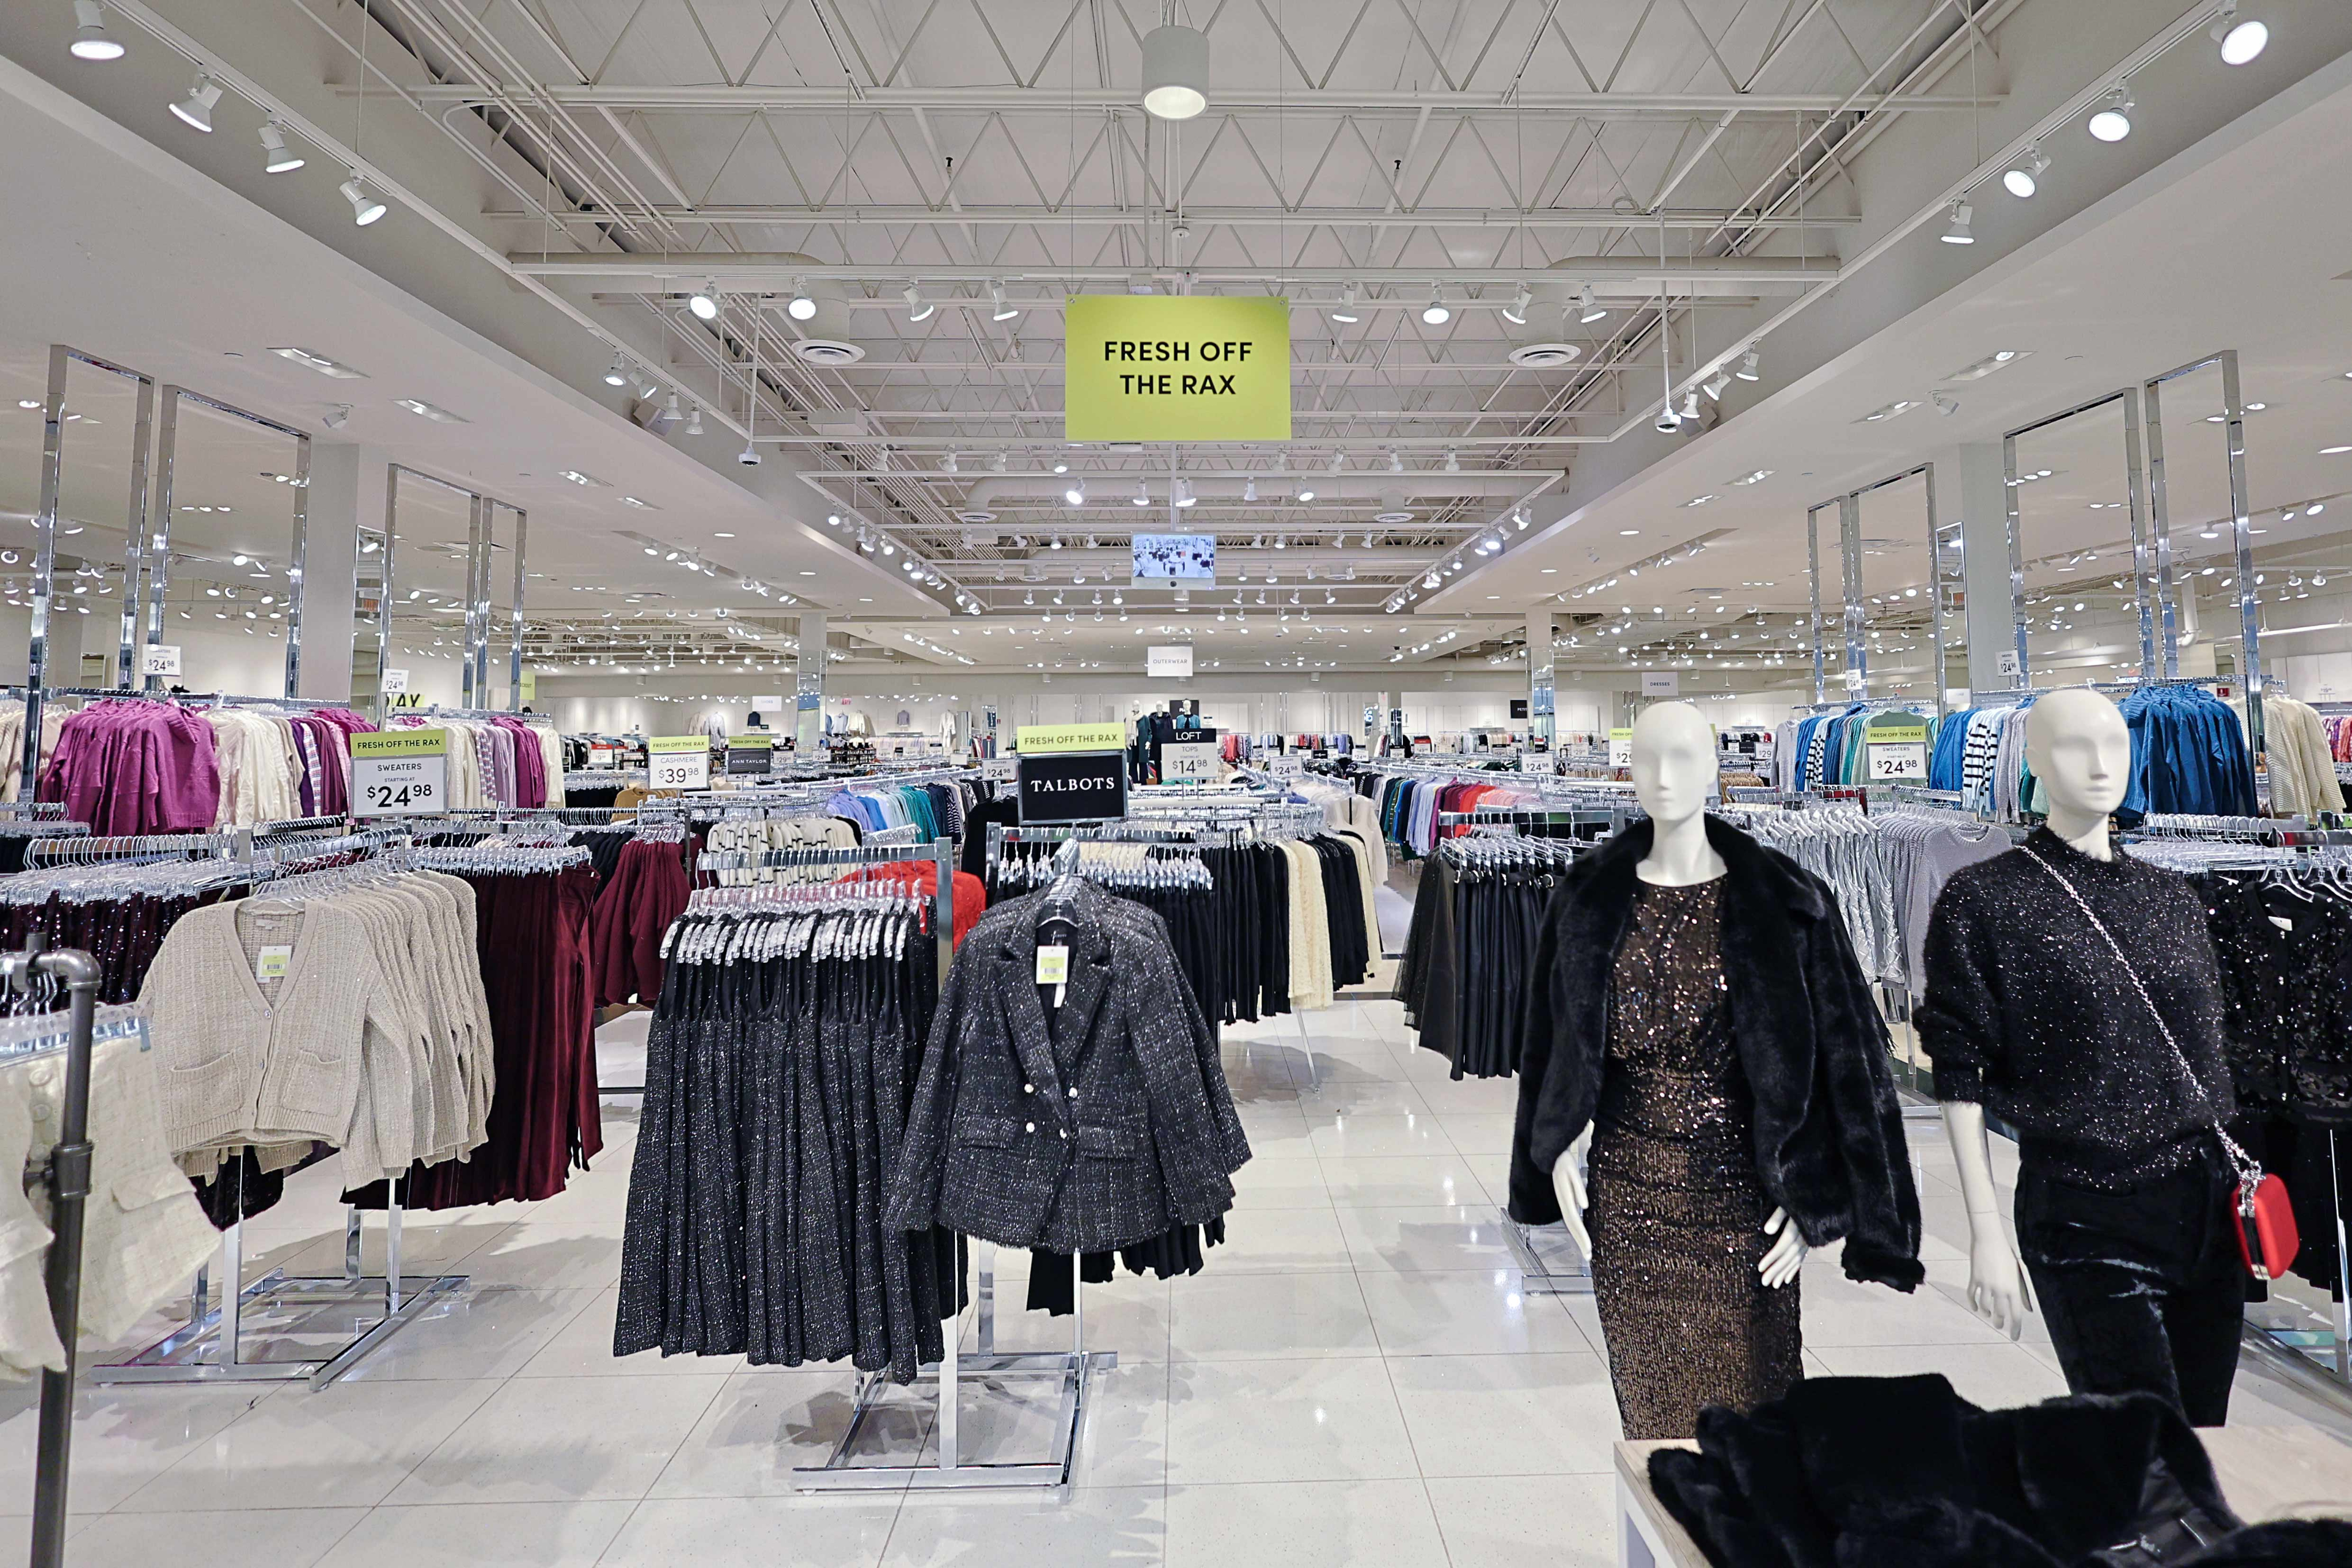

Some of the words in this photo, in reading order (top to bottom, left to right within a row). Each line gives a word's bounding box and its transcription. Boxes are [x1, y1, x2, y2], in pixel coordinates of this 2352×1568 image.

[1105, 342, 1190, 361] FRESH
[1200, 342, 1252, 362] OFF
[1120, 375, 1171, 394] THE
[1182, 375, 1236, 394] RAX
[1024, 737, 1054, 745] FRESH
[1057, 735, 1074, 744] OFF
[1077, 735, 1094, 743] THE
[1098, 734, 1117, 742] RAX
[1176, 731, 1202, 740] LOFT
[386, 740, 402, 748] OFF
[377, 763, 422, 772] SWEATERS
[1031, 777, 1115, 792] TALBOTS
